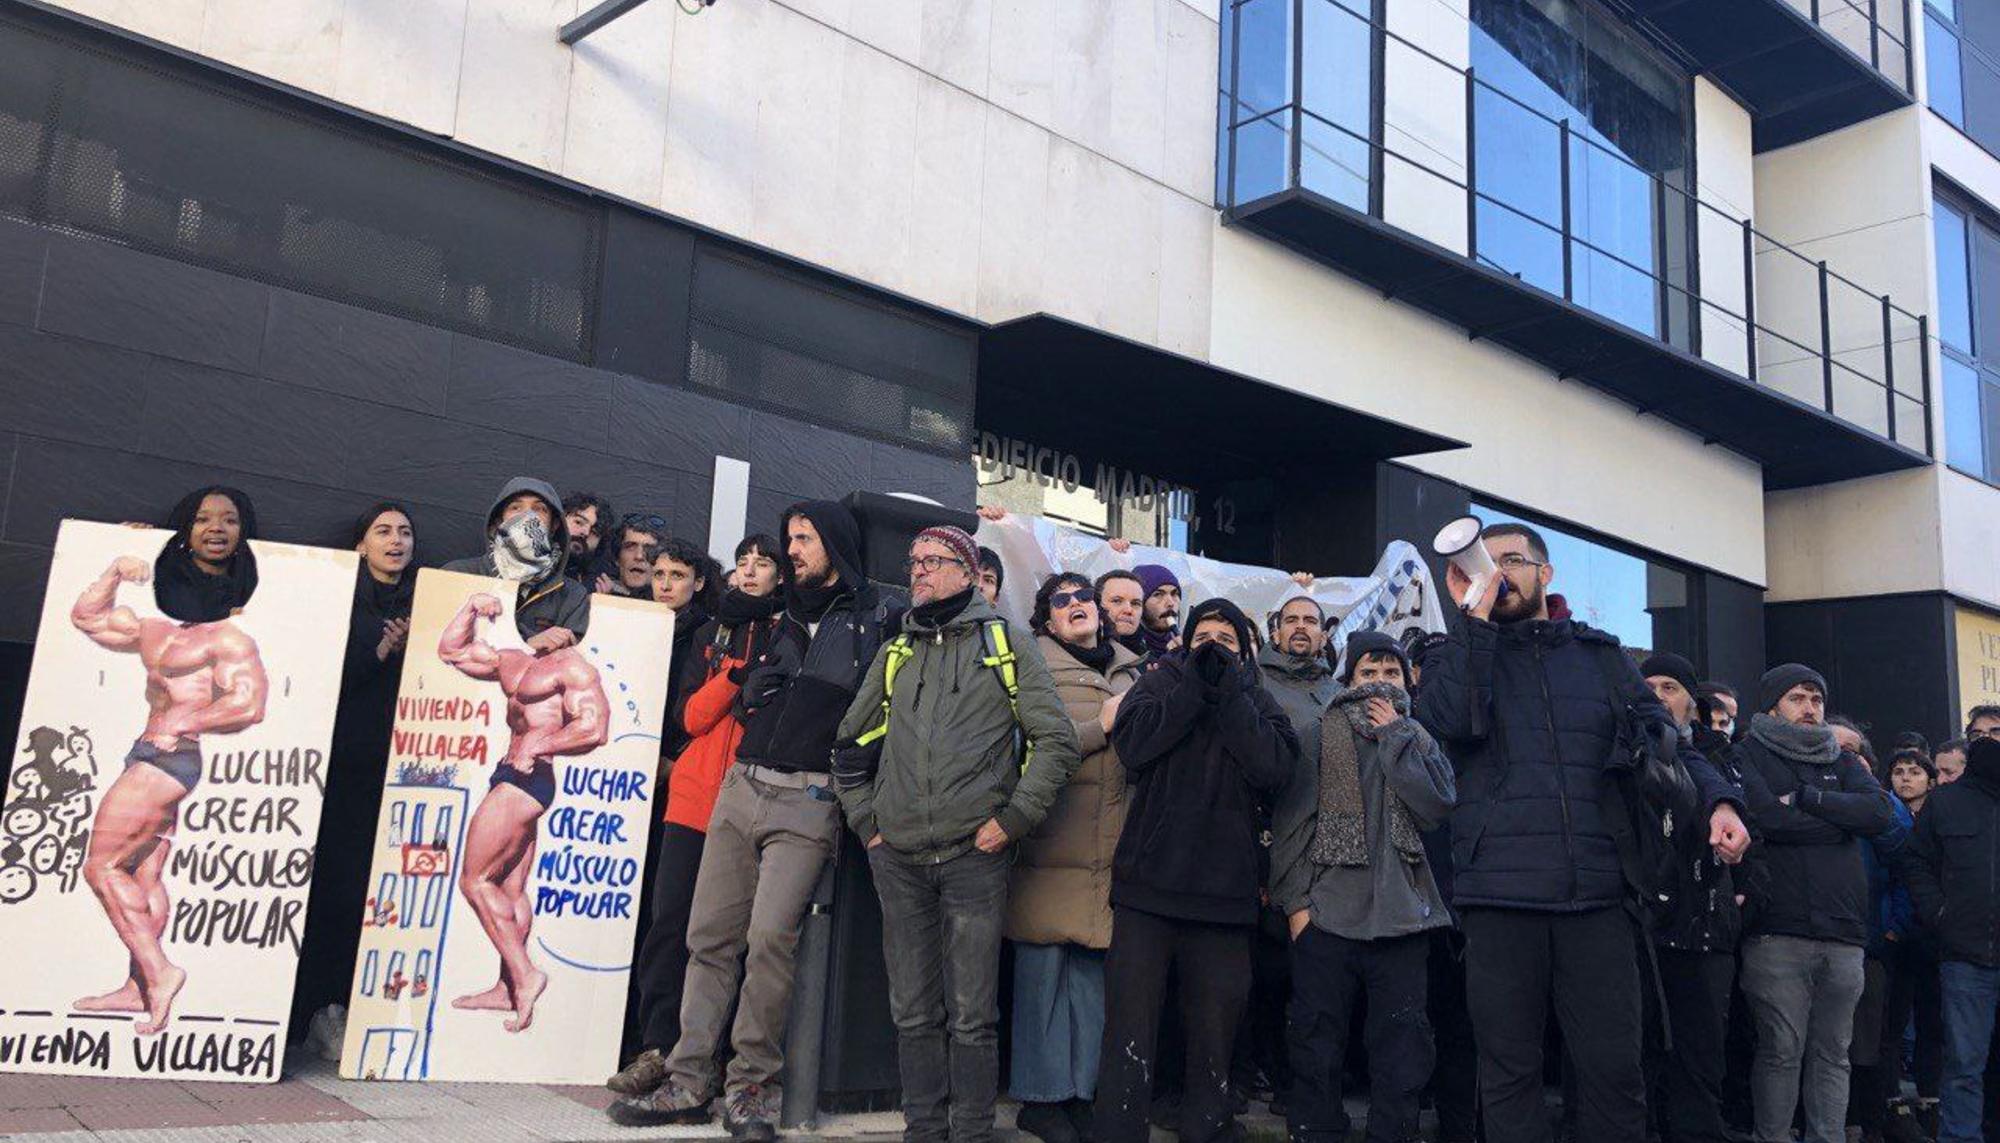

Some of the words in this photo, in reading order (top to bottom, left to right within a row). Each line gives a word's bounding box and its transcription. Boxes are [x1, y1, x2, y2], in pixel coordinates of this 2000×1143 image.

[1213, 496, 1237, 536] 12
[398, 696, 490, 727] VIVIENDA
[393, 729, 488, 765] VILLALBA
[208, 747, 325, 798] LUCHAR
[563, 765, 647, 802] LUCHAR
[184, 796, 302, 836] CREAR
[548, 806, 627, 845] CREAR
[537, 844, 637, 888] MÚSCULO
[534, 886, 632, 919] POPULAR
[170, 896, 301, 961] POPULAR
[134, 1032, 276, 1078] VILLALBA
